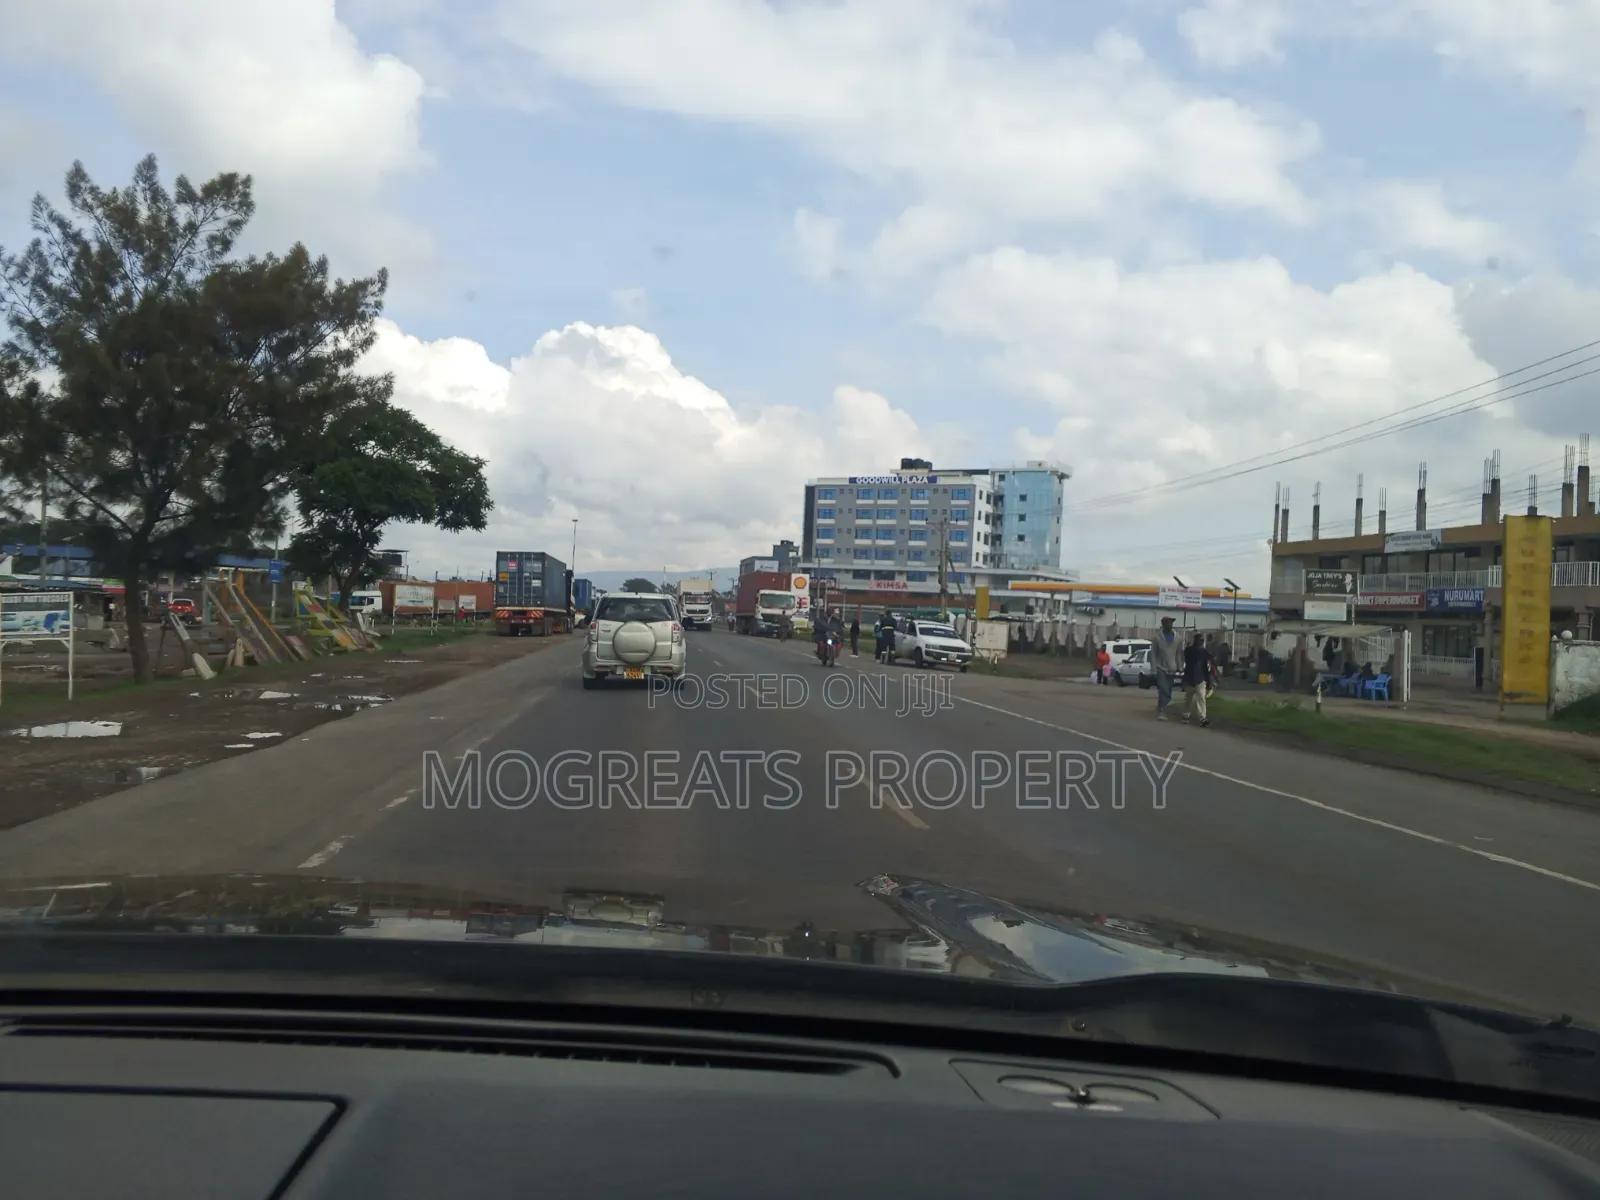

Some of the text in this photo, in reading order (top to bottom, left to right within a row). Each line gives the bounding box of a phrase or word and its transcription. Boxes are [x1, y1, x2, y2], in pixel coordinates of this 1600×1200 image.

[856, 475, 928, 484] GOODWILL PLAZA
[876, 581, 908, 590] KIMSA
